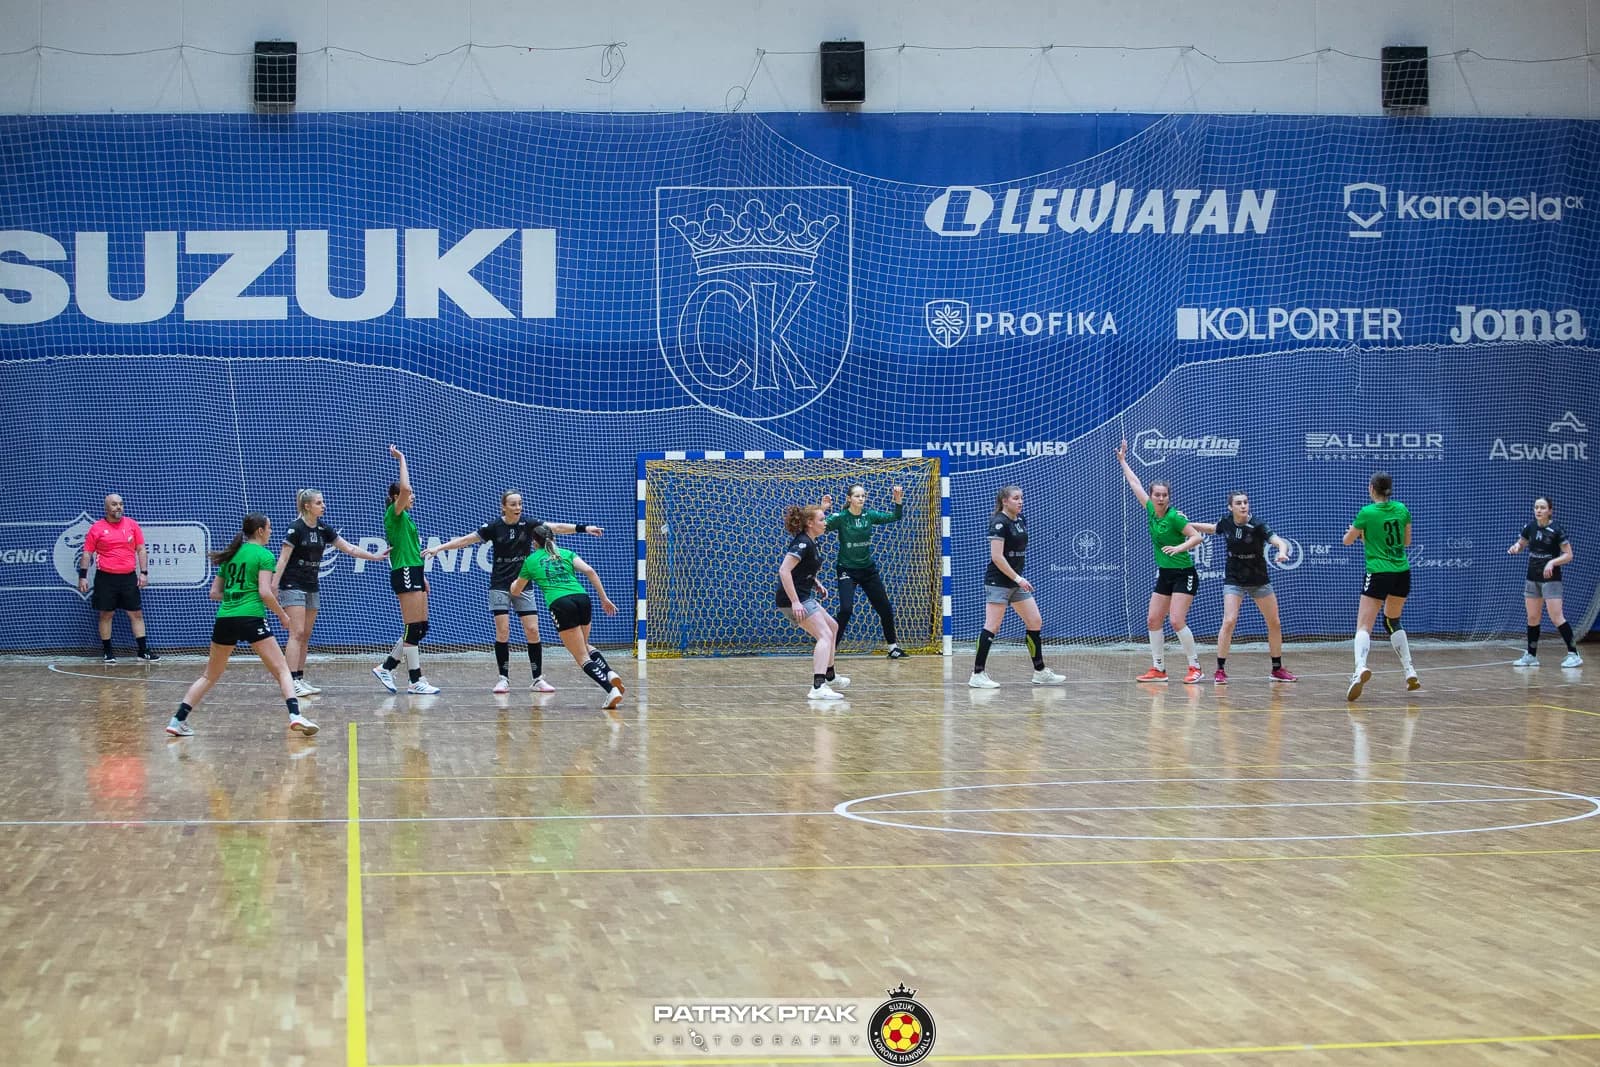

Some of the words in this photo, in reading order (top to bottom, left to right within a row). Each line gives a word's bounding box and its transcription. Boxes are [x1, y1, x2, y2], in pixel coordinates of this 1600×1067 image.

[998, 181, 1277, 235] LEWIATAN
[1397, 190, 1562, 221] karabela
[1564, 196, 1584, 209] CK
[0, 228, 557, 325] SUZUKI
[678, 279, 818, 391] CK
[975, 311, 1118, 336] PROFIKA
[1200, 307, 1403, 341] KOLPORTER
[1449, 305, 1587, 343] Joma
[926, 440, 1068, 457] NATURAL-MED
[1143, 435, 1240, 449] endorfina
[1325, 433, 1443, 448] ALUTOR
[1488, 438, 1588, 461] Aswent
[1383, 520, 1402, 547] 31
[145, 543, 197, 554] ERLIGA
[149, 558, 179, 566] BIET
[225, 562, 246, 590] 34
